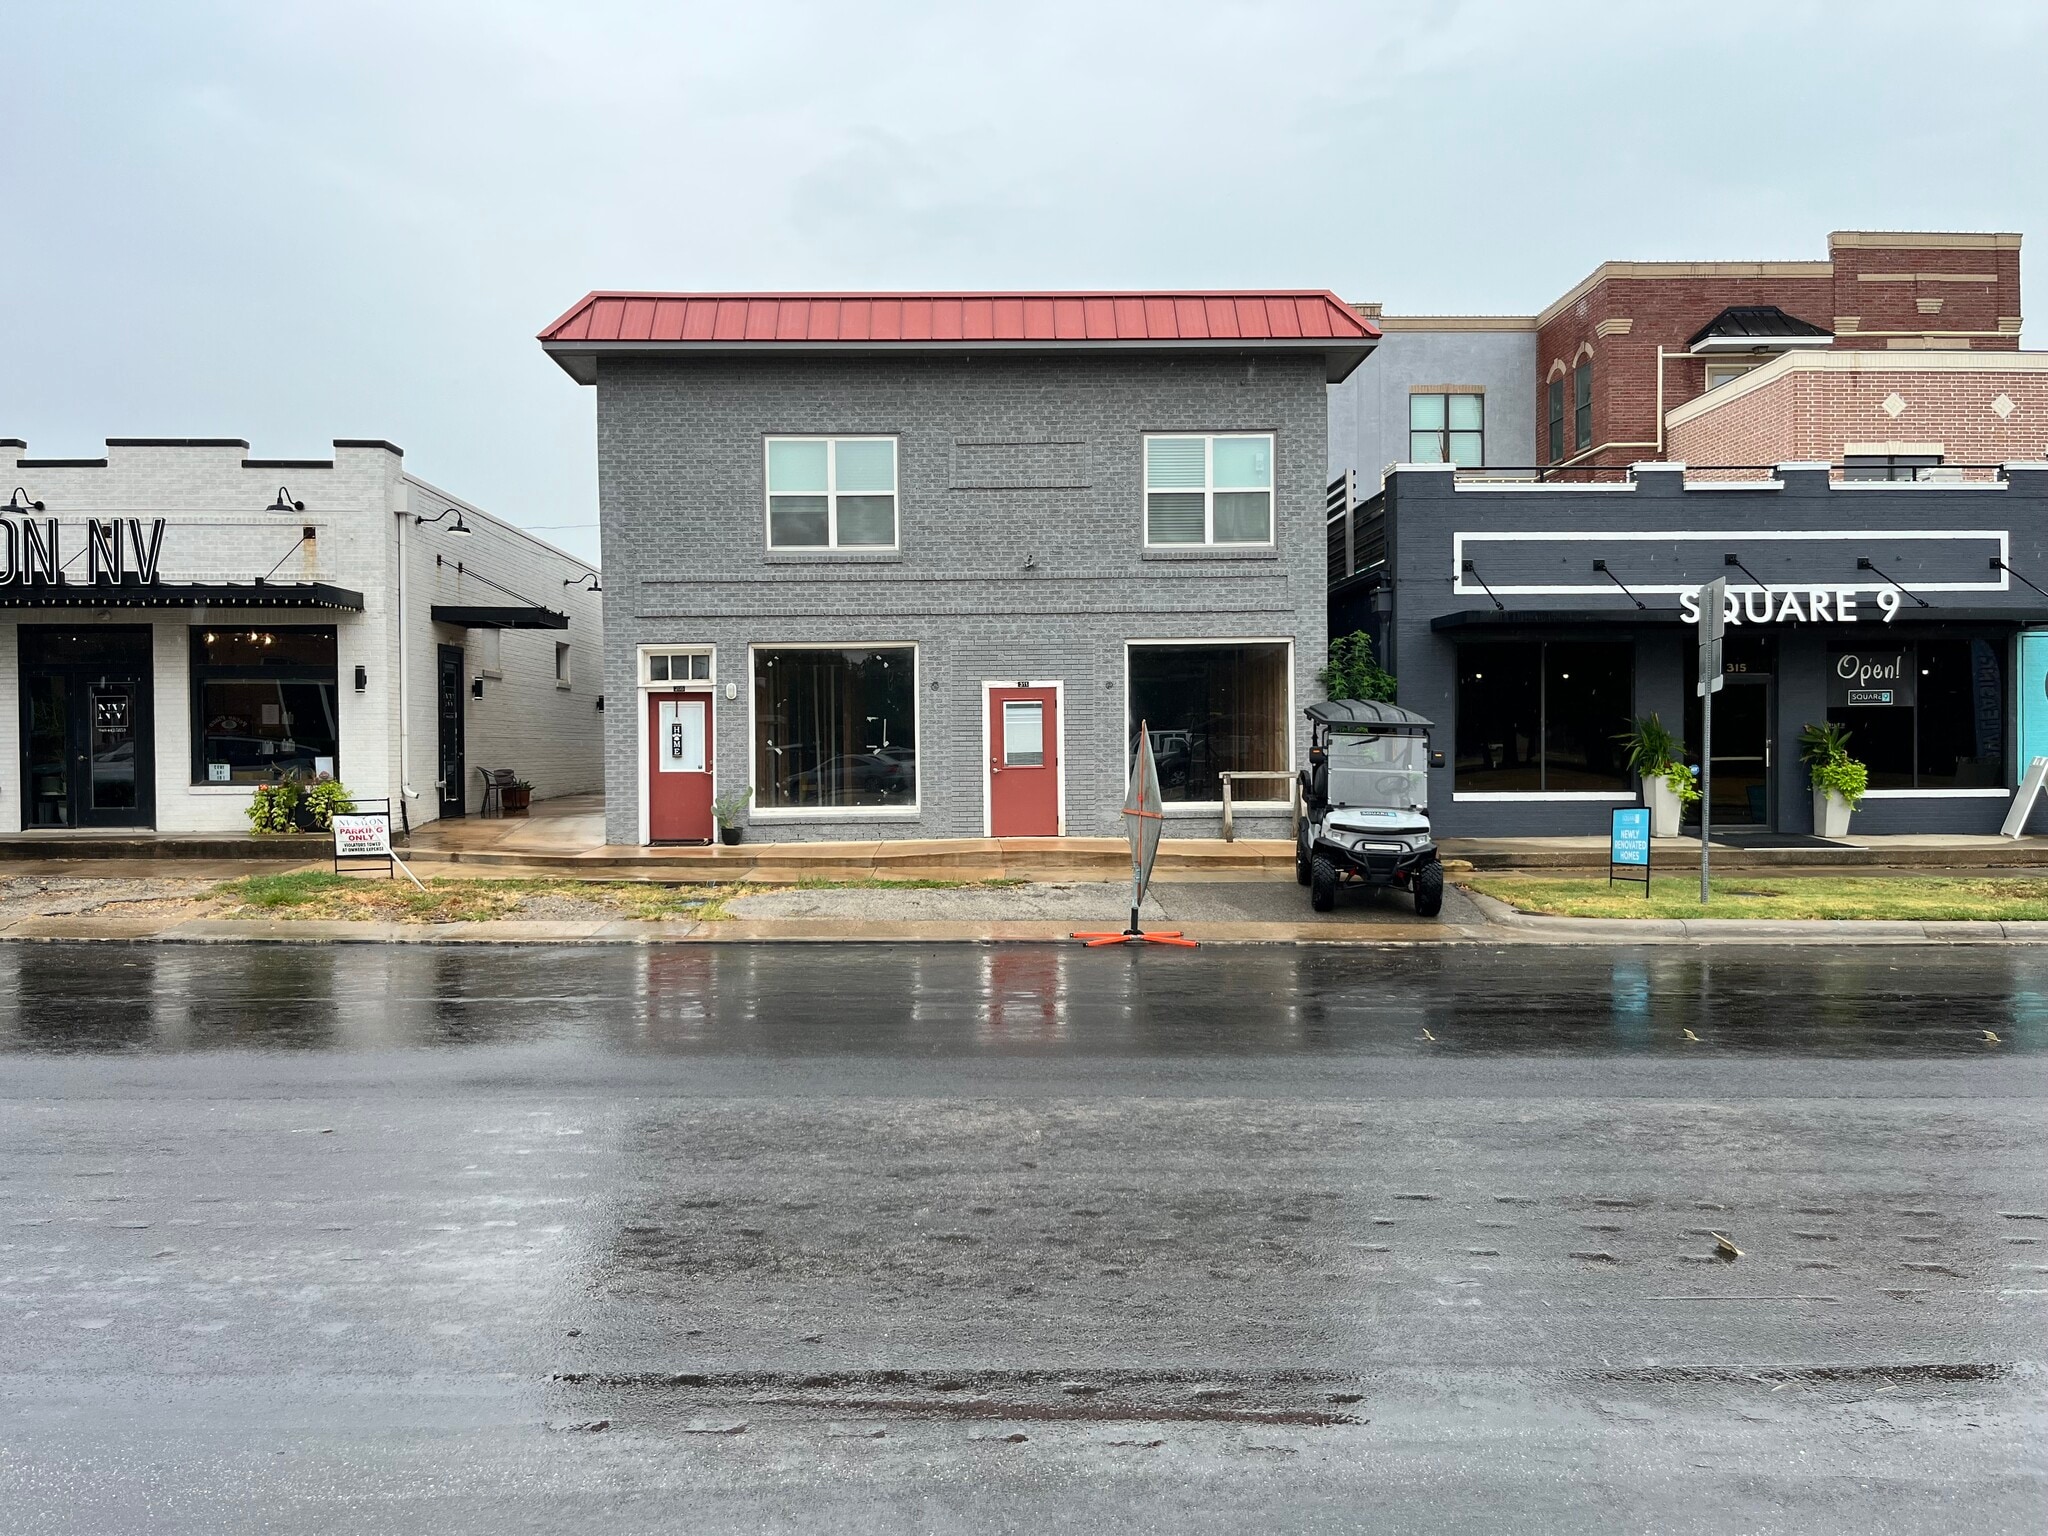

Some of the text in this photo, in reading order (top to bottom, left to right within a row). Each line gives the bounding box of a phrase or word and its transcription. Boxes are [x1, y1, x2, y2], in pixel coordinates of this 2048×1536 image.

[87, 518, 166, 585] NV
[1876, 589, 1901, 623] 9
[1726, 663, 1747, 673] 315
[1837, 654, 1902, 687] Open!
[354, 818, 384, 826] SAON
[348, 834, 374, 842] ONLY
[1620, 829, 1640, 839] NEWLY
[1614, 840, 1647, 850] RENOVATED
[1620, 851, 1640, 860] HOMES
